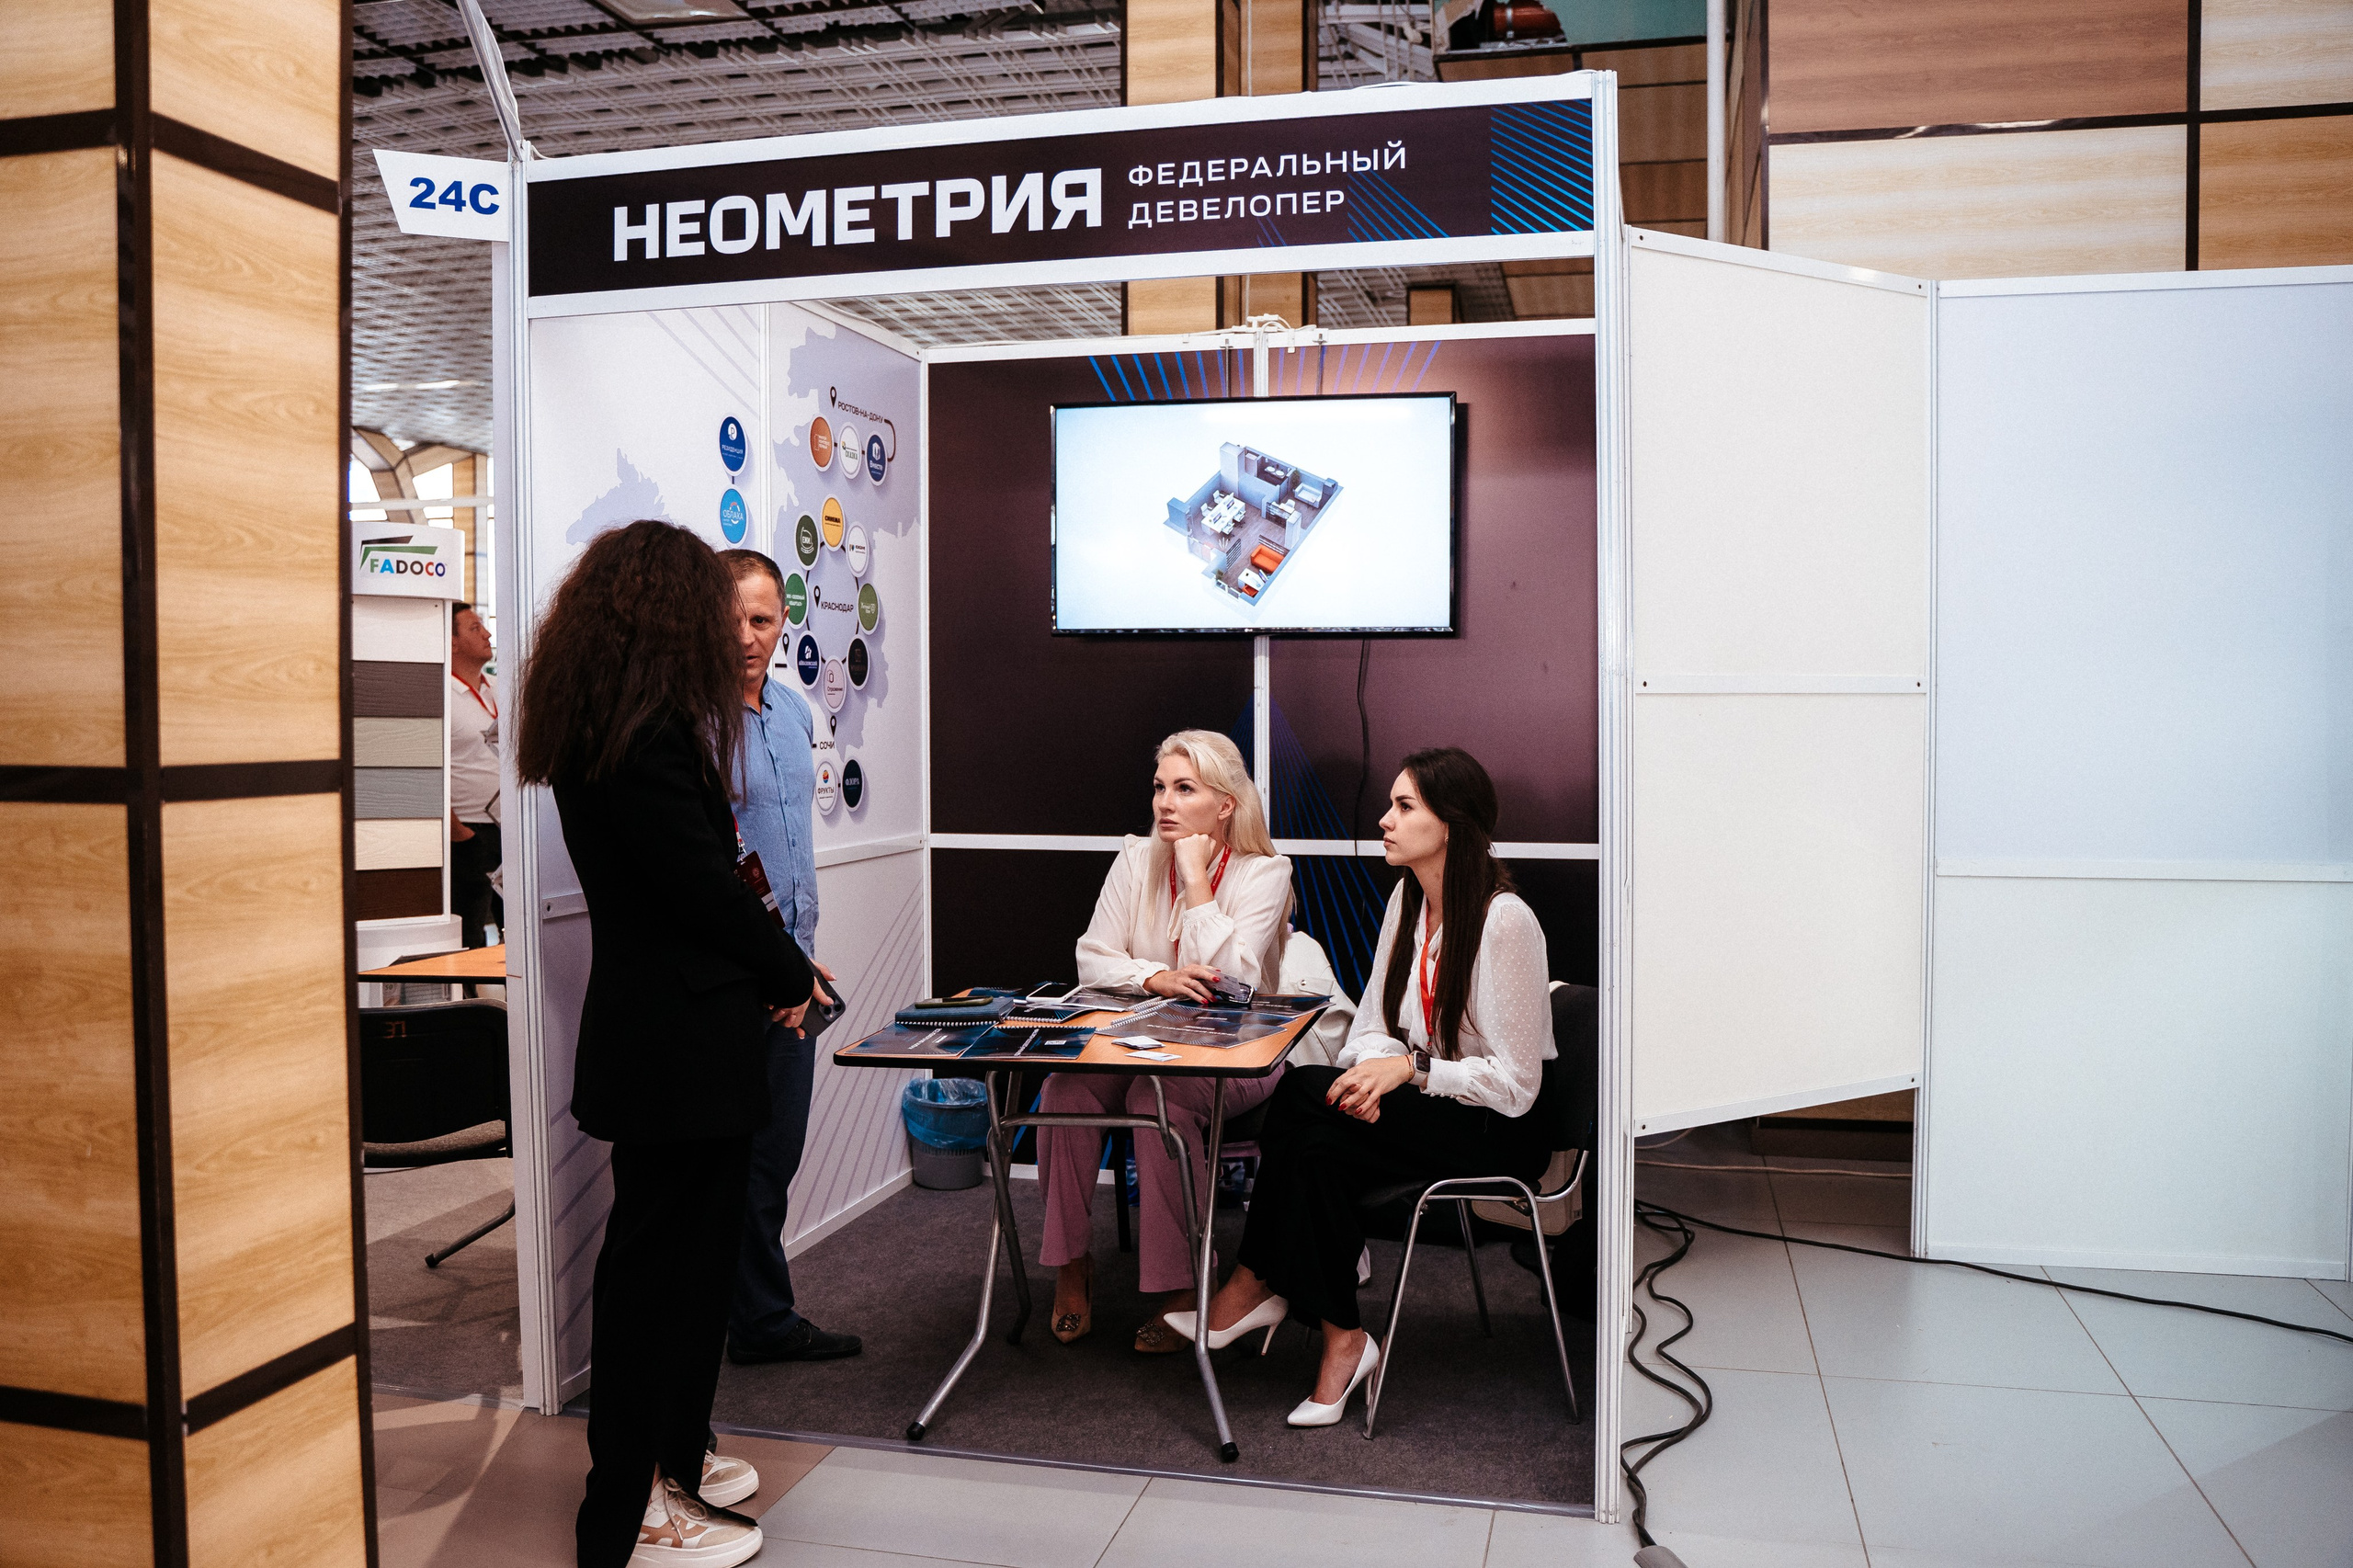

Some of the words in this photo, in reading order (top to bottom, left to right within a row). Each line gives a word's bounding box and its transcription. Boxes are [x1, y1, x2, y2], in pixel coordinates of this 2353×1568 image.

[1128, 140, 1405, 187] ФЕДЕРАЛЬНЫЙ
[614, 168, 1102, 261] НЕОМЕТРИЯ
[1128, 189, 1345, 229] ДЕВЕЛОПЕР
[369, 558, 446, 577] FADOCO
[821, 601, 854, 613] КРАСНОДАР
[819, 741, 835, 750] СОЧИ
